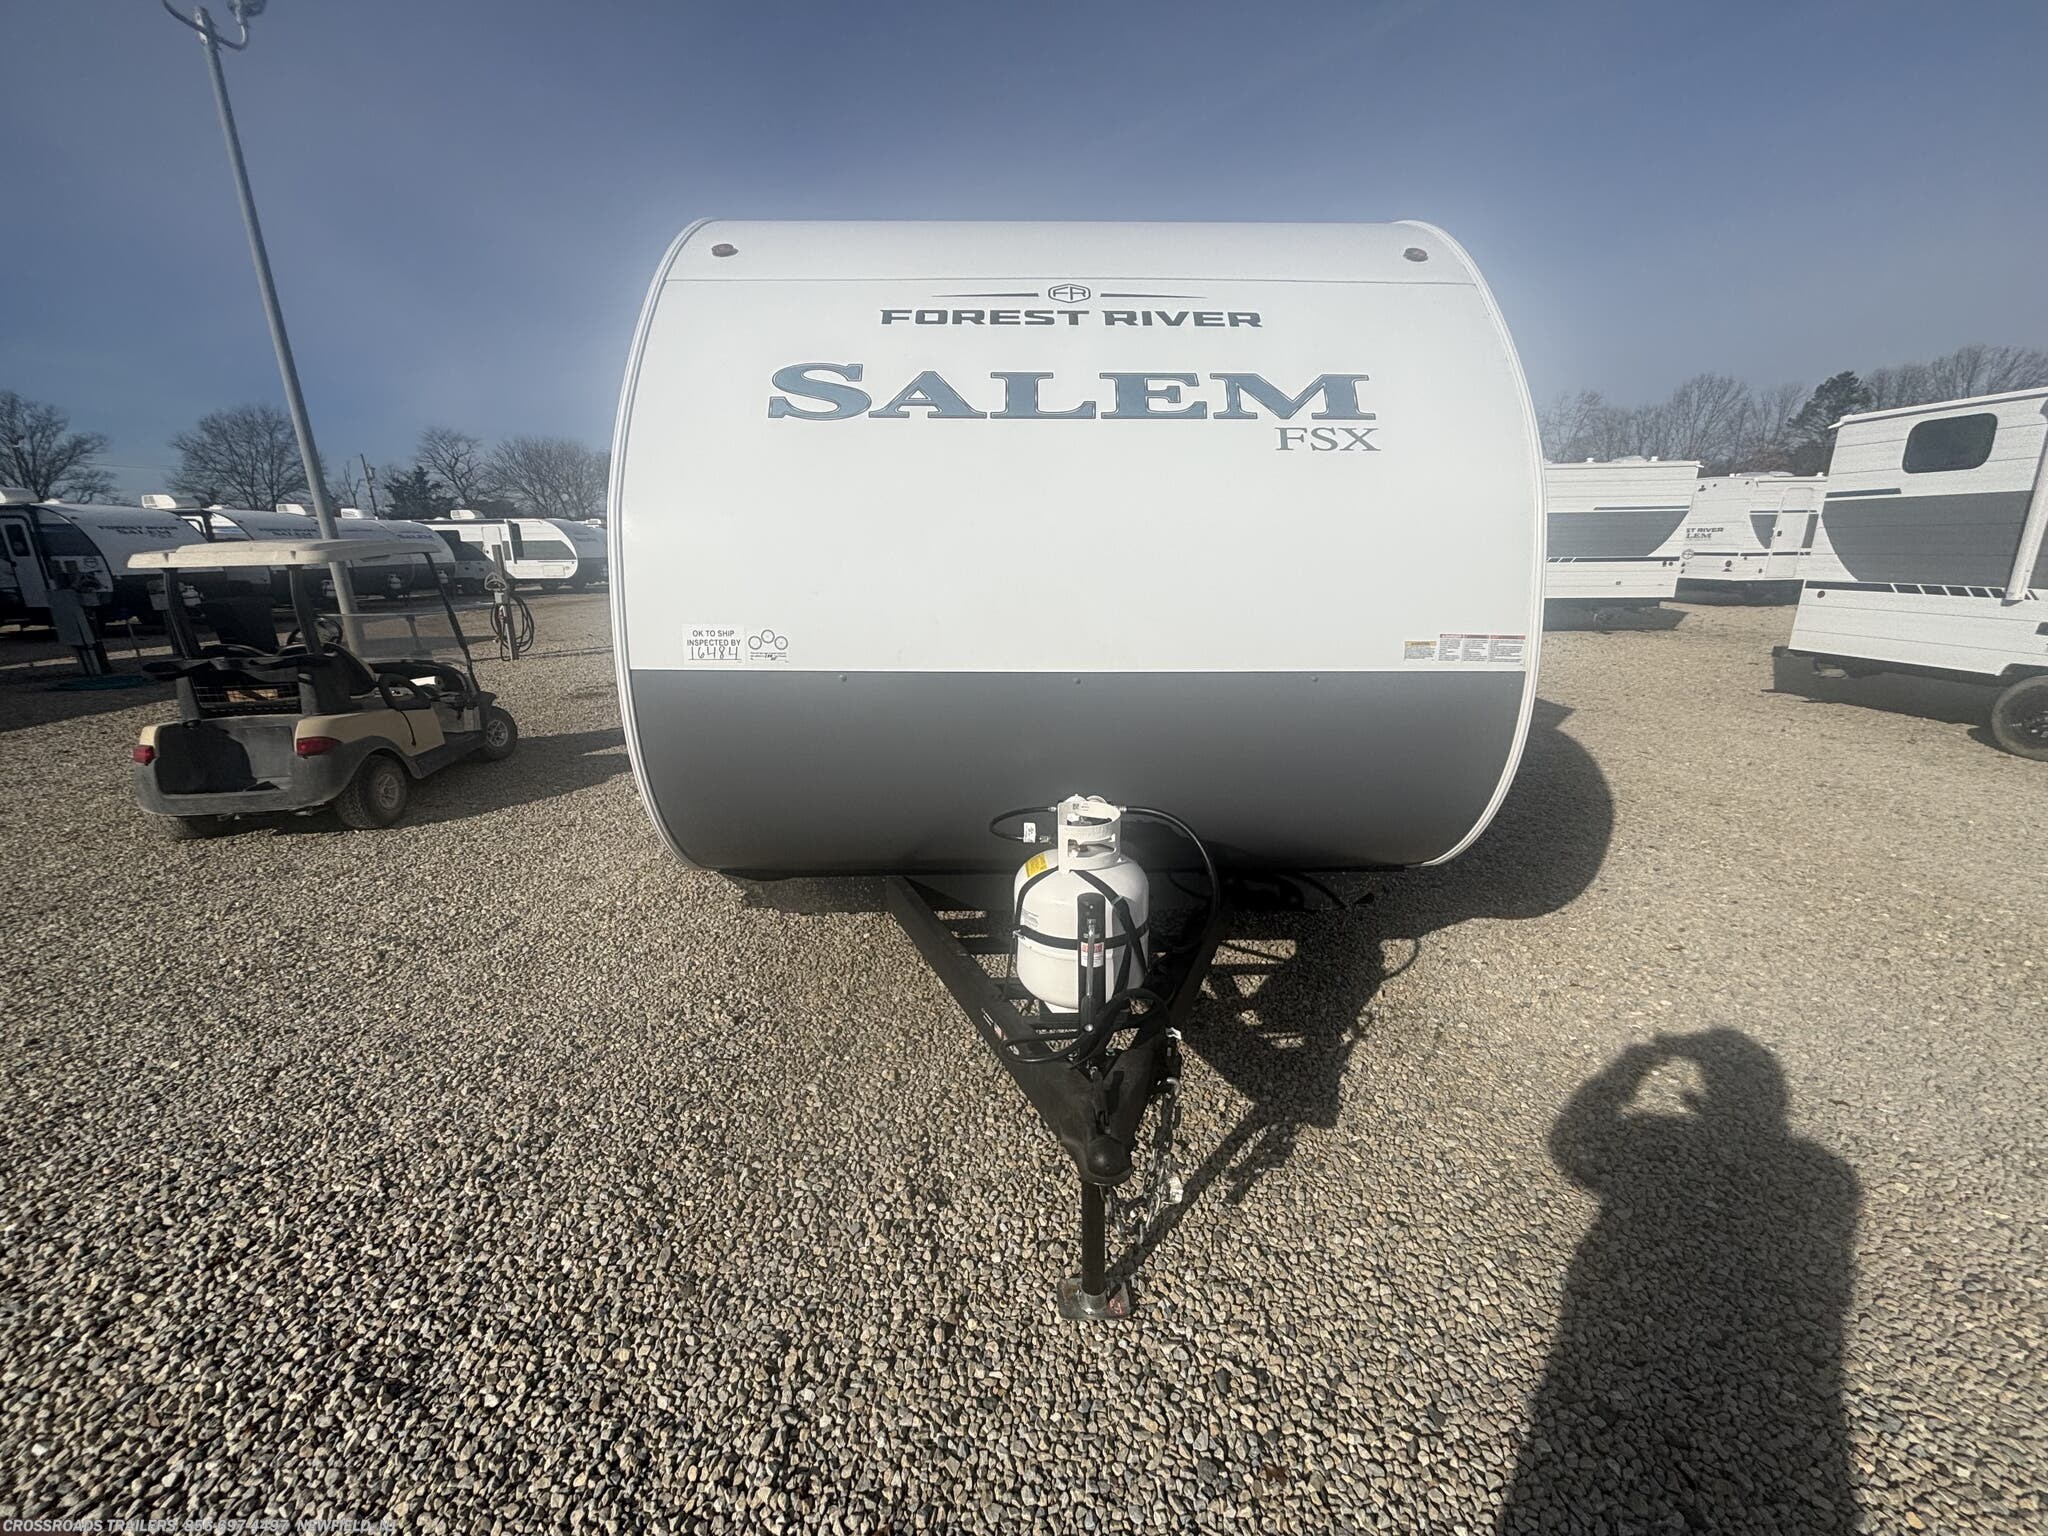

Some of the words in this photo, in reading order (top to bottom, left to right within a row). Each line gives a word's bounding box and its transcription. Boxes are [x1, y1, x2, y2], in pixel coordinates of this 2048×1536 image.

[880, 309, 1090, 326] FOREST
[1102, 309, 1263, 328] RIVER
[768, 362, 1377, 421] SALEM
[1275, 427, 1381, 452] FSX
